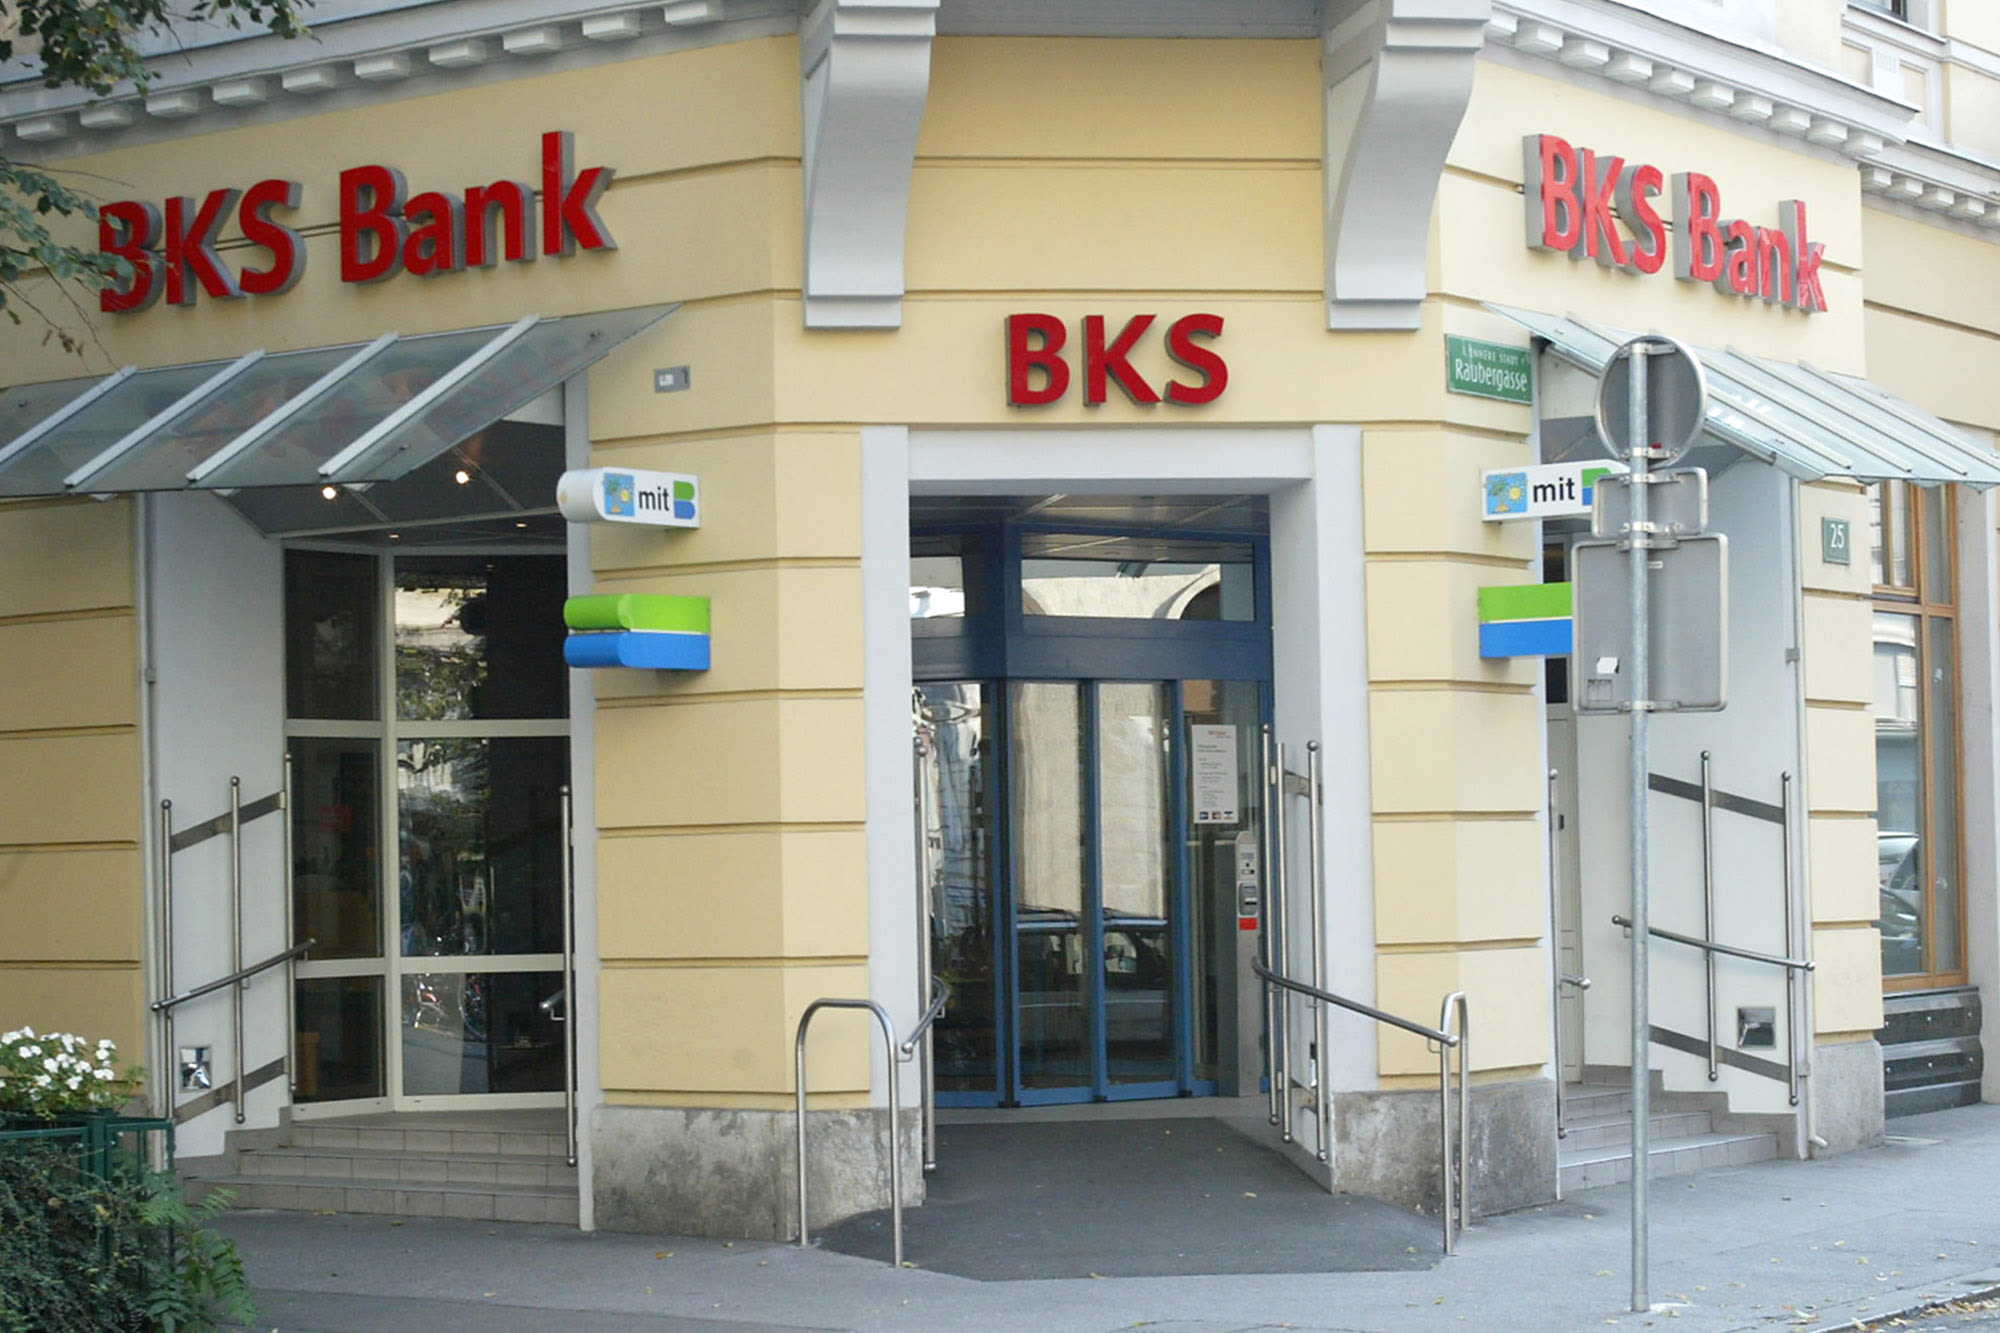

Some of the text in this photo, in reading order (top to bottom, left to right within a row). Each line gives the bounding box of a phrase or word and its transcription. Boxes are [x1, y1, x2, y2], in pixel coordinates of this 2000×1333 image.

[100, 131, 617, 312] BKS Bank
[1523, 134, 1828, 313] BKS Bank
[1004, 313, 1228, 407] BKS
[1455, 358, 1528, 391] Raubergasse
[638, 485, 670, 512] mit
[1533, 476, 1575, 503] mit
[1830, 523, 1845, 549] 25
